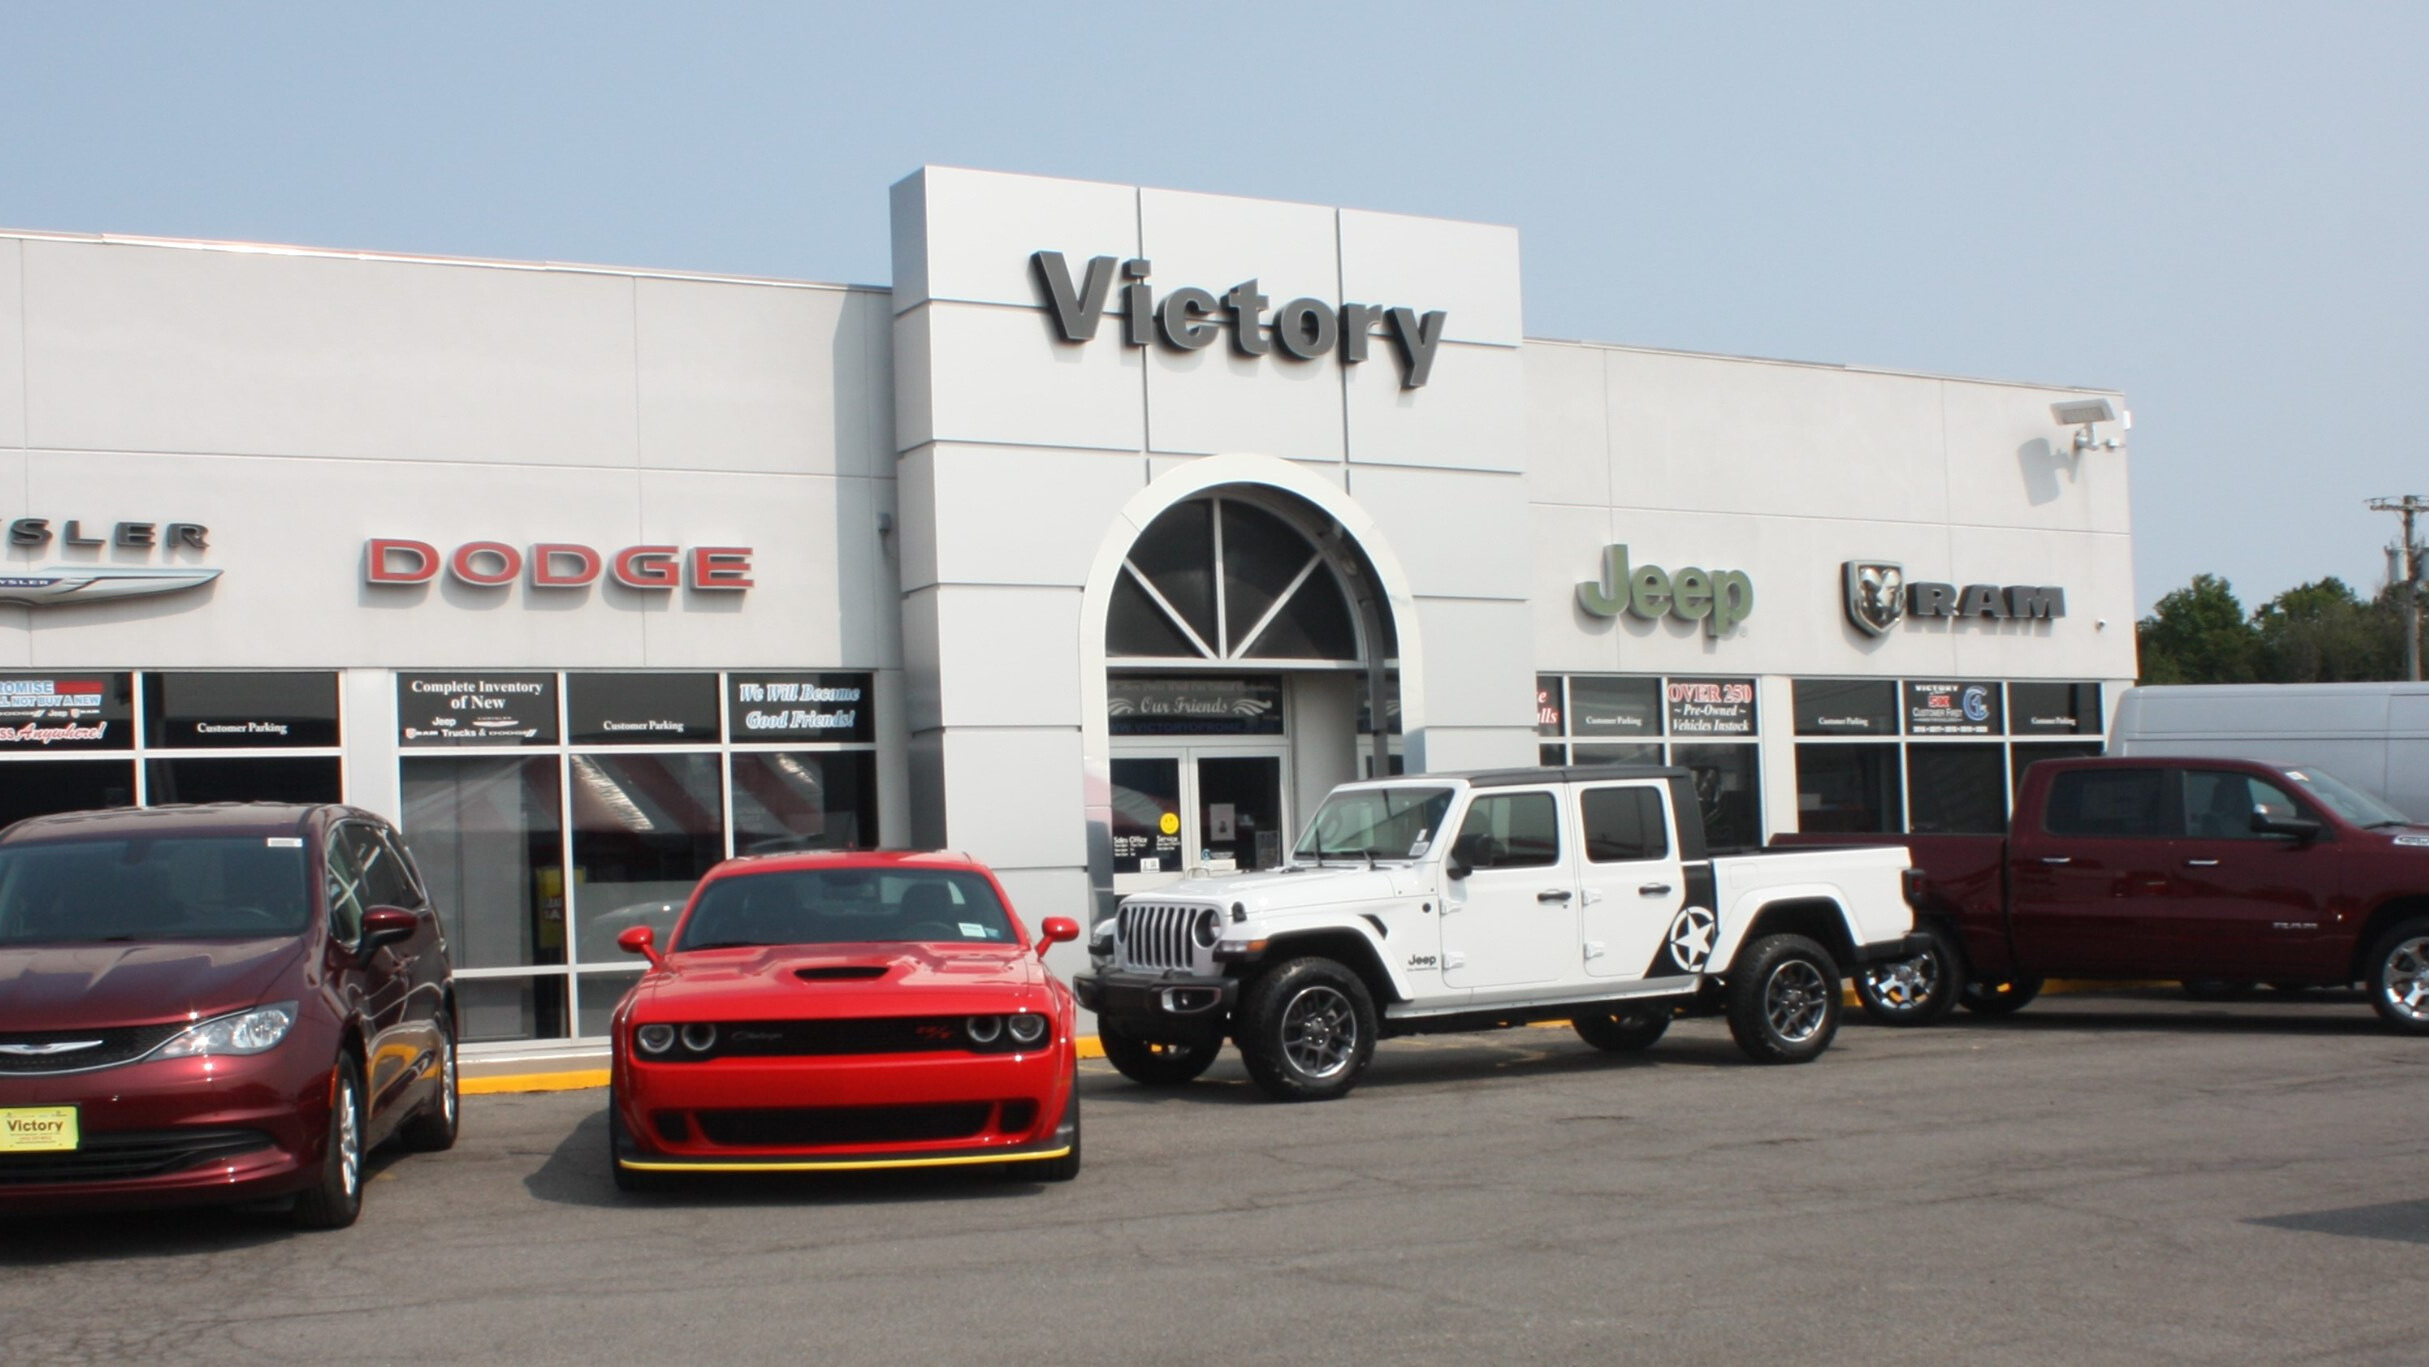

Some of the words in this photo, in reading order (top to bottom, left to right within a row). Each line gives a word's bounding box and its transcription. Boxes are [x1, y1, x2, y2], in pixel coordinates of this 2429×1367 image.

[1031, 251, 1447, 389] Victory
[0, 518, 210, 549] SLER
[366, 538, 754, 590] DODGE
[1576, 544, 1753, 638] Jeep
[1905, 581, 2066, 620] RAM
[412, 680, 475, 695] Complete
[479, 680, 543, 695] Inventory
[740, 683, 764, 701] We
[766, 683, 799, 702] Will
[799, 684, 860, 702] Become
[1667, 683, 1722, 703] OVER
[1723, 684, 1753, 703] 250
[11, 695, 37, 707] NOT
[37, 694, 62, 707] BUY
[62, 694, 74, 706] A
[74, 694, 101, 706] NEW
[450, 695, 468, 709] of
[471, 695, 506, 709] New
[1140, 695, 1169, 713] Our
[1173, 696, 1227, 713] Friends
[1683, 704, 1738, 716] Pre-Owned
[432, 717, 456, 728] Jeep
[603, 720, 648, 731] Customer
[648, 720, 684, 733] Parking
[746, 710, 789, 729] Good
[789, 709, 855, 728] Friends!
[1673, 719, 1712, 731] Vehicles
[1713, 719, 1749, 731] Instock
[15, 721, 107, 744] Anywhere!
[197, 722, 247, 733] Customer
[248, 722, 287, 735] Parking
[441, 729, 476, 737] Trucks
[1408, 954, 1437, 966] Jeep
[8, 1119, 63, 1132] Victory
